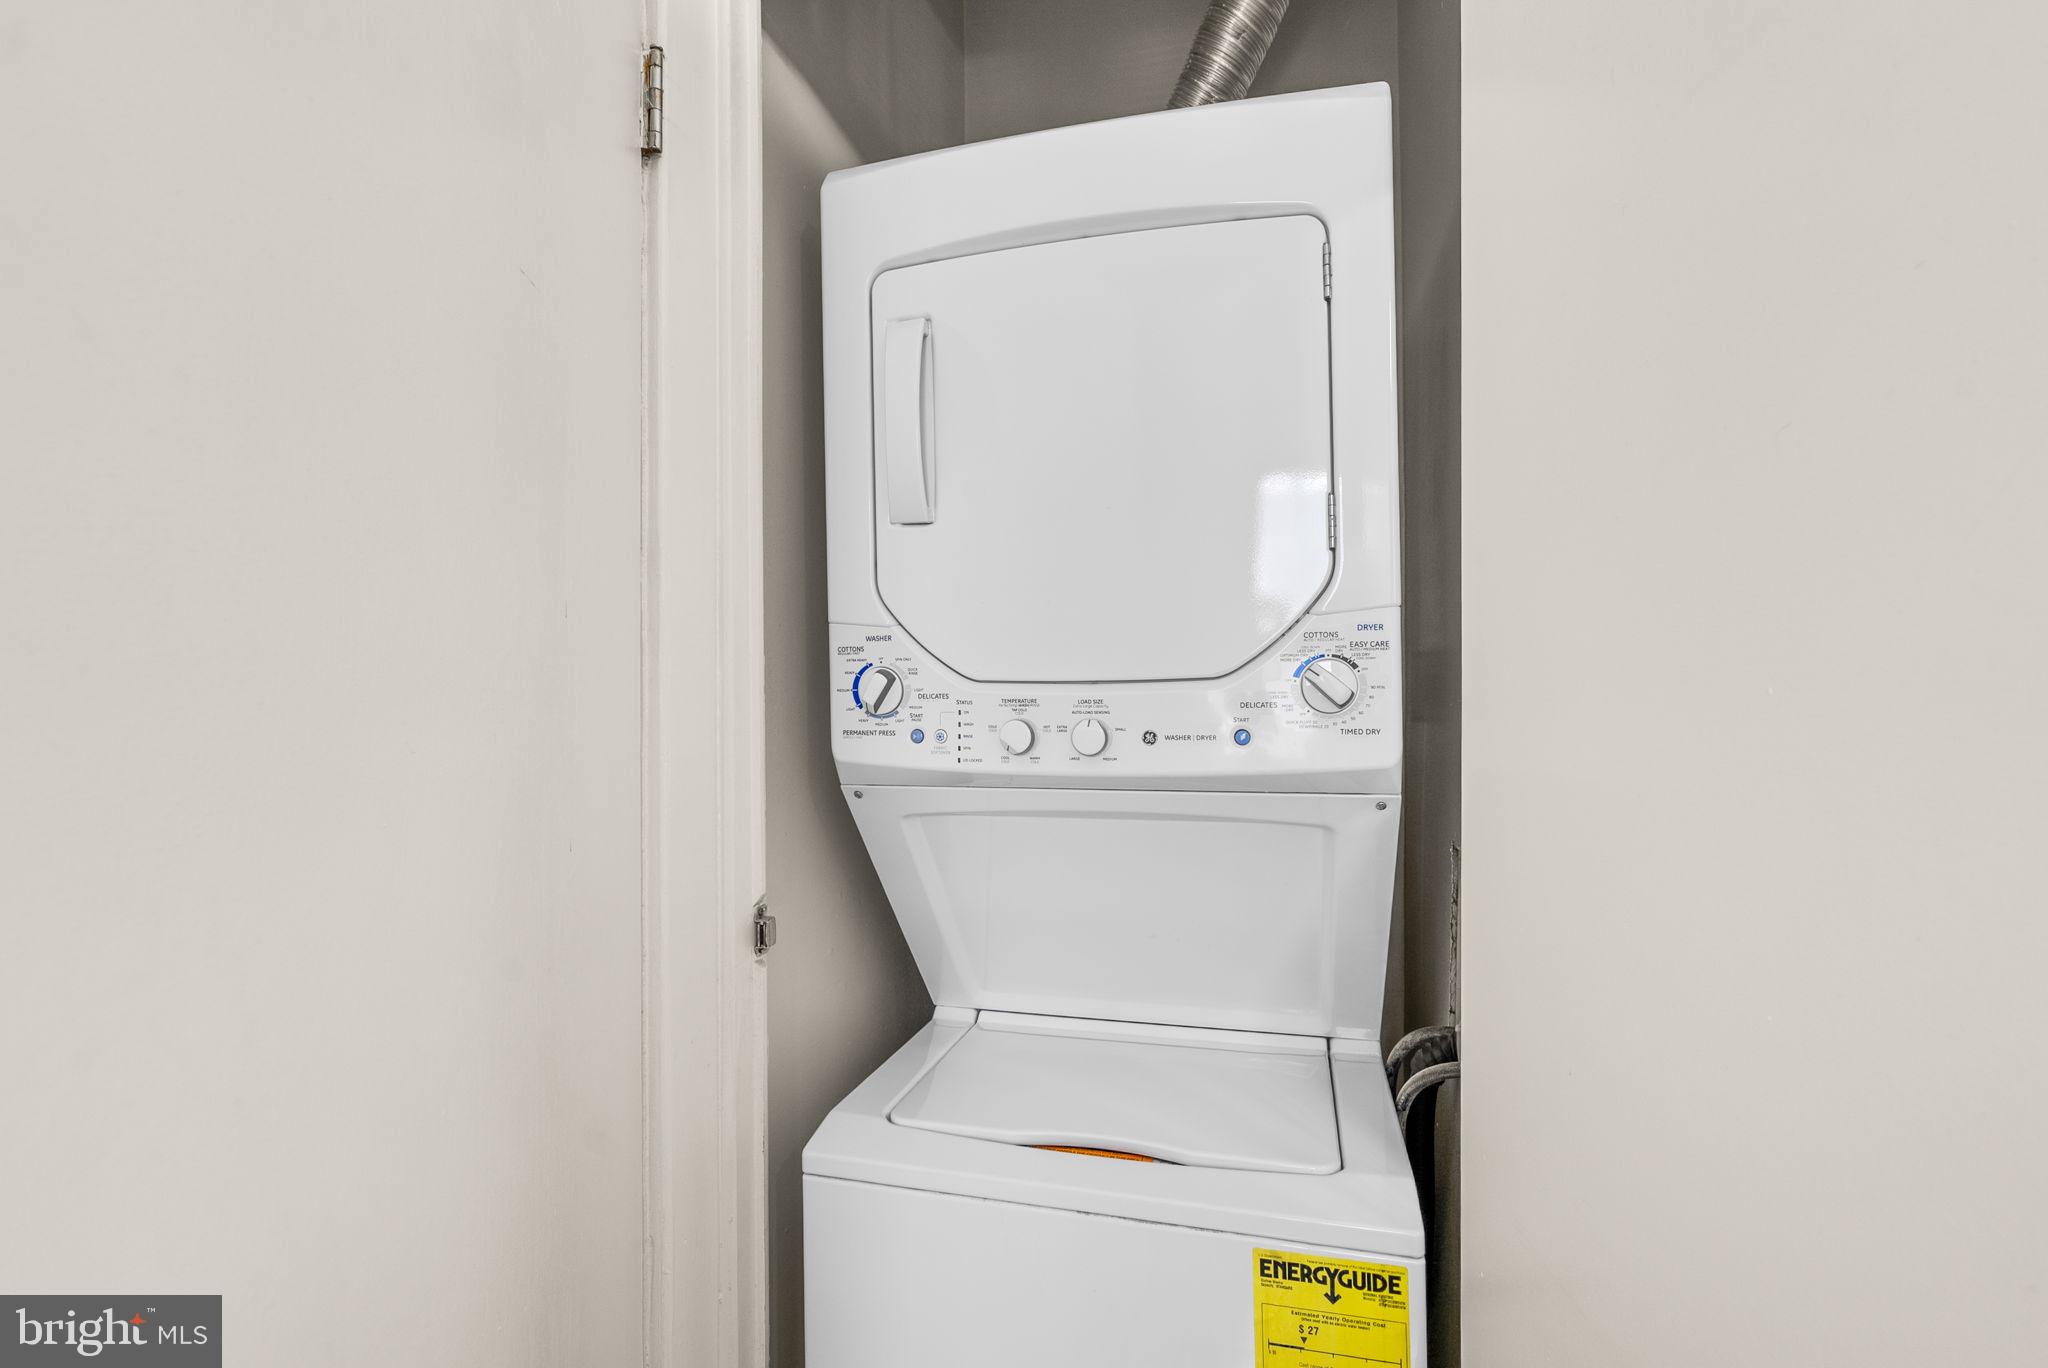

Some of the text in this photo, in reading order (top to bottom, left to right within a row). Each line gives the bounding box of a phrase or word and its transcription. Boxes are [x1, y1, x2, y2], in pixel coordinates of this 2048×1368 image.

[865, 634, 893, 642] WASHER
[1303, 631, 1339, 639] COTTONS
[1349, 640, 1390, 648] EASY CARE
[1260, 1258, 1402, 1295] ENERGYGUIDE
[1291, 1310, 1386, 1329] Estimated Yearly Operating Cost
[1298, 1324, 1319, 1336] $ 27
